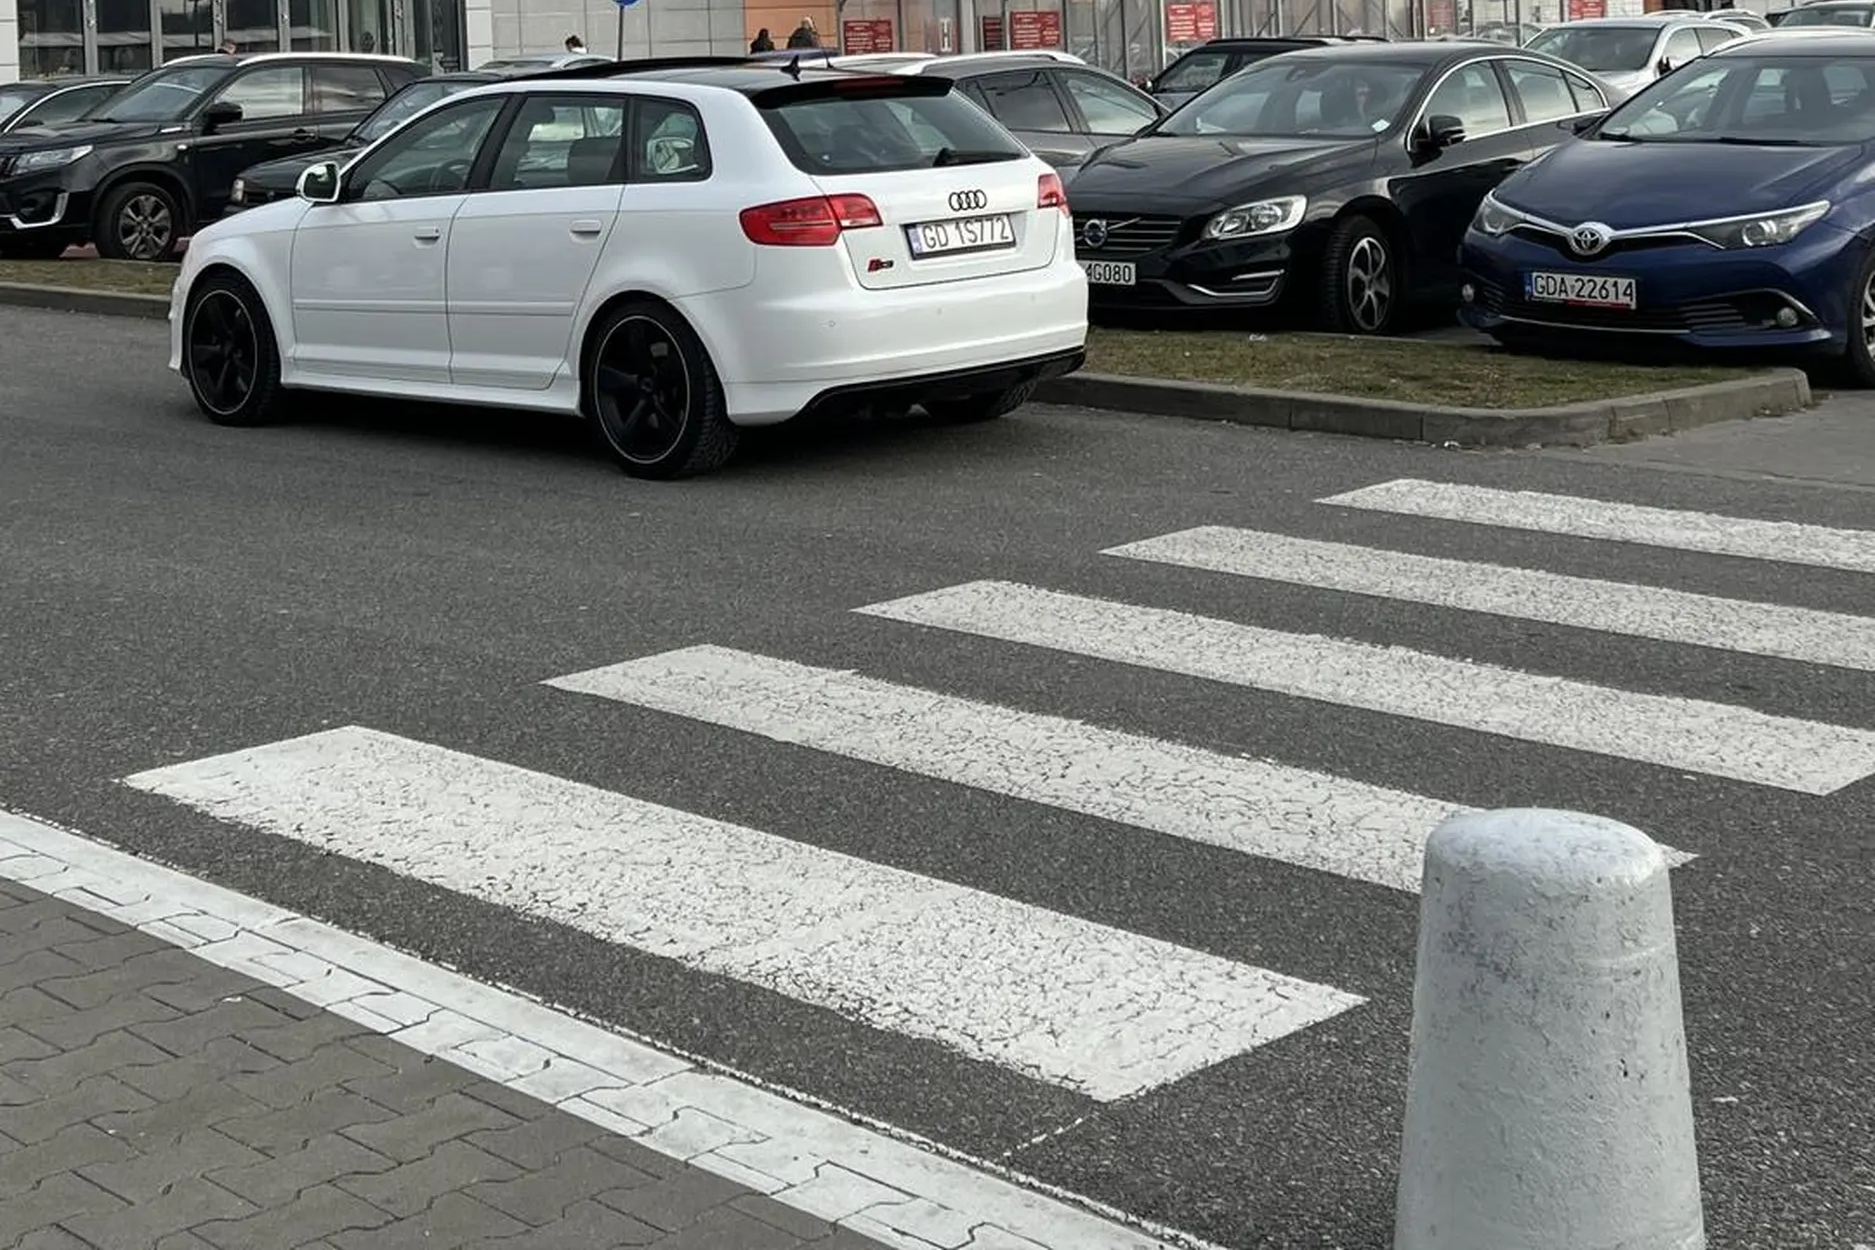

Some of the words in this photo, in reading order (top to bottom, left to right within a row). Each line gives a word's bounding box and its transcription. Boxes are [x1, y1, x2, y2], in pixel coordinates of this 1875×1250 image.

[922, 224, 949, 249] GD
[1534, 275, 1569, 297] GDA
[1574, 278, 1634, 302] 22614
